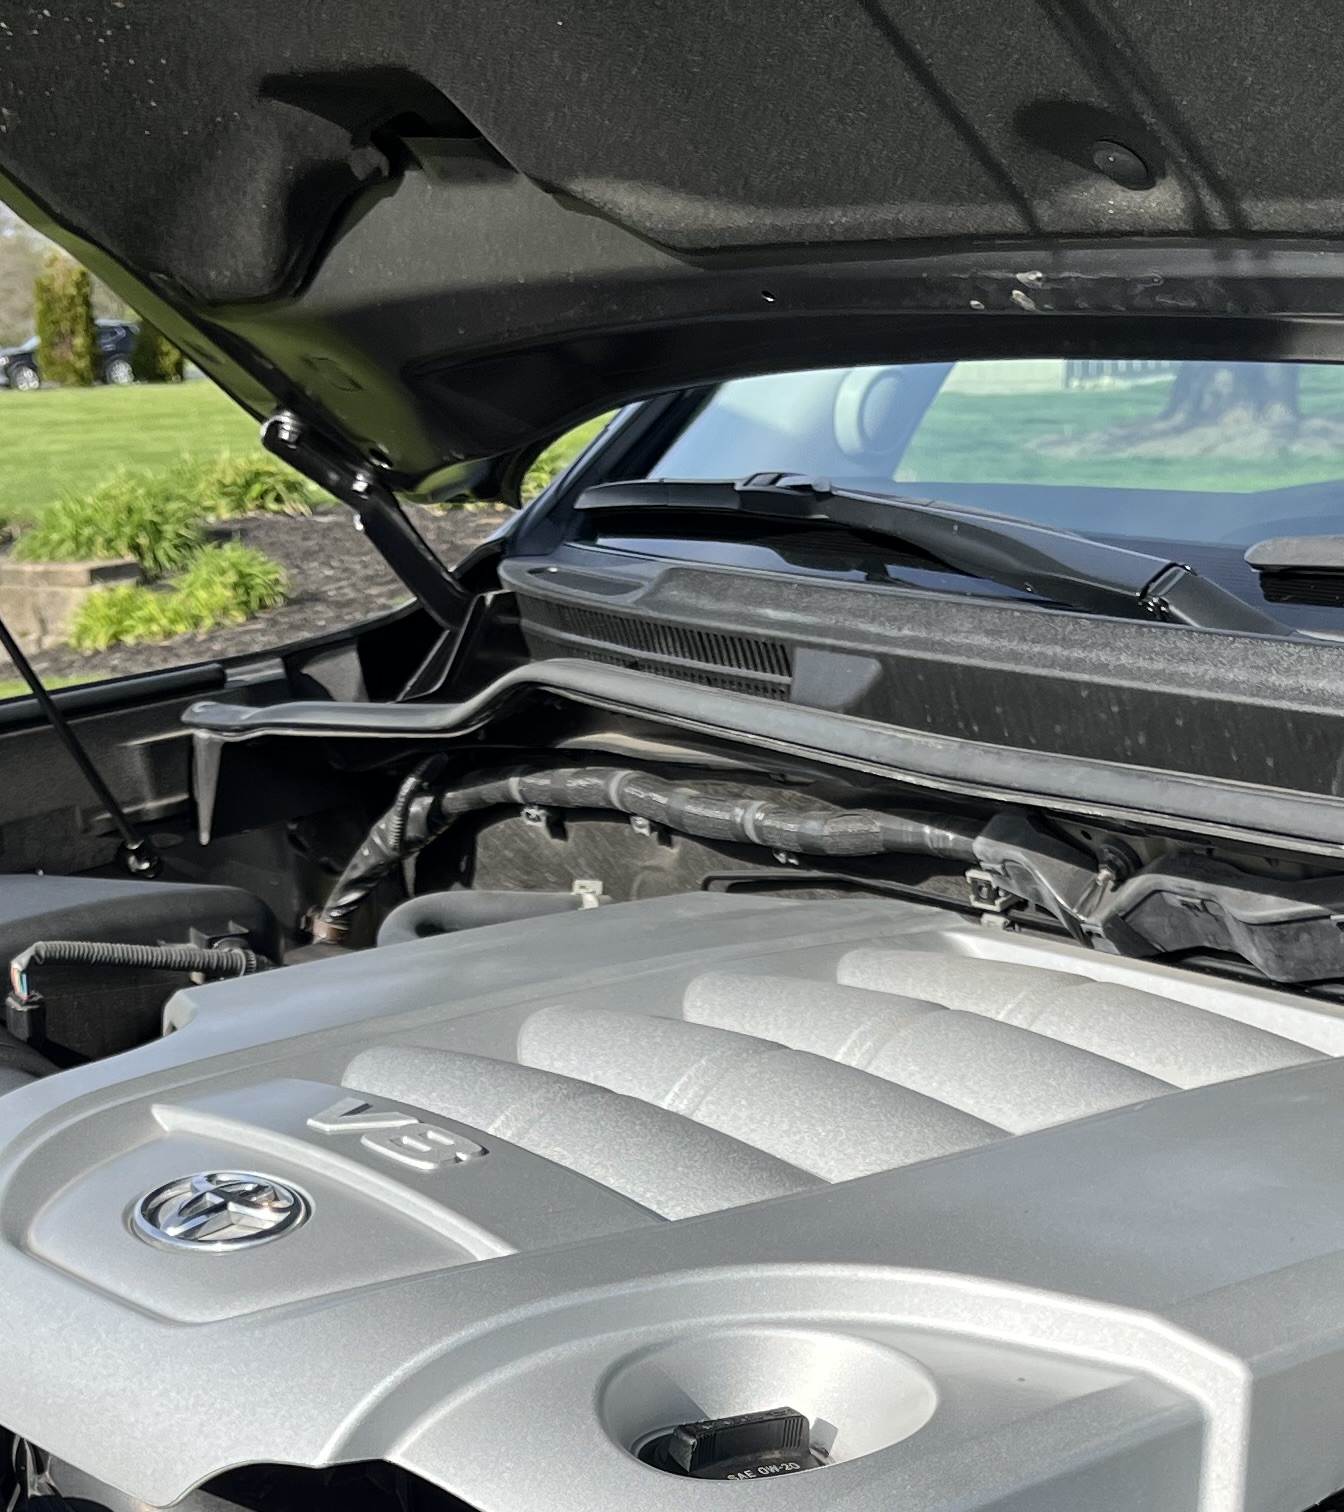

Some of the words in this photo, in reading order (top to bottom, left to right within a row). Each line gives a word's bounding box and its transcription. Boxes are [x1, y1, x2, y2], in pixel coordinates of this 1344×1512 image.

[306, 1097, 490, 1171] V8
[727, 1469, 756, 1481] SAE
[757, 1462, 801, 1478] 0W-20
